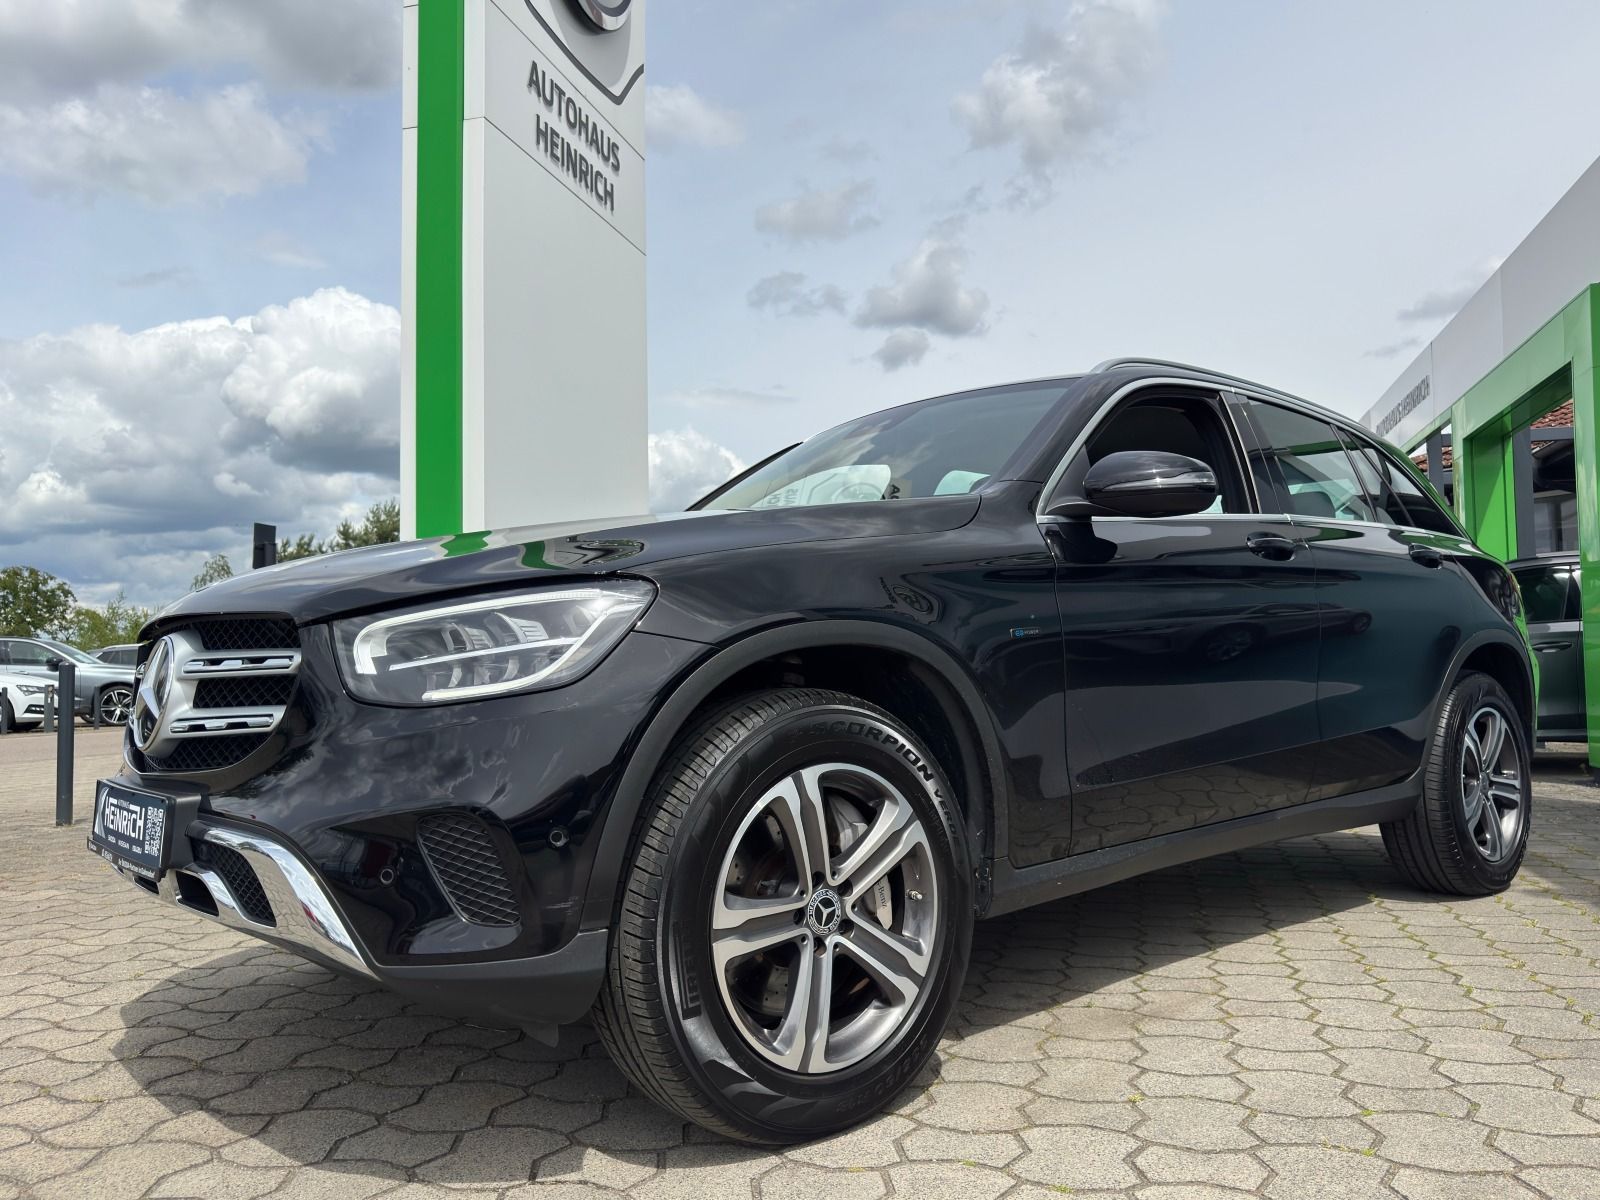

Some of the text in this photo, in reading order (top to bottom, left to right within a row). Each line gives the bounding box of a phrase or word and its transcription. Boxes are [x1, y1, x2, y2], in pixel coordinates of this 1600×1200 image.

[527, 60, 620, 172] AUTOHAUS
[536, 113, 614, 212] HEINRICH
[809, 721, 934, 782] SCORPION
